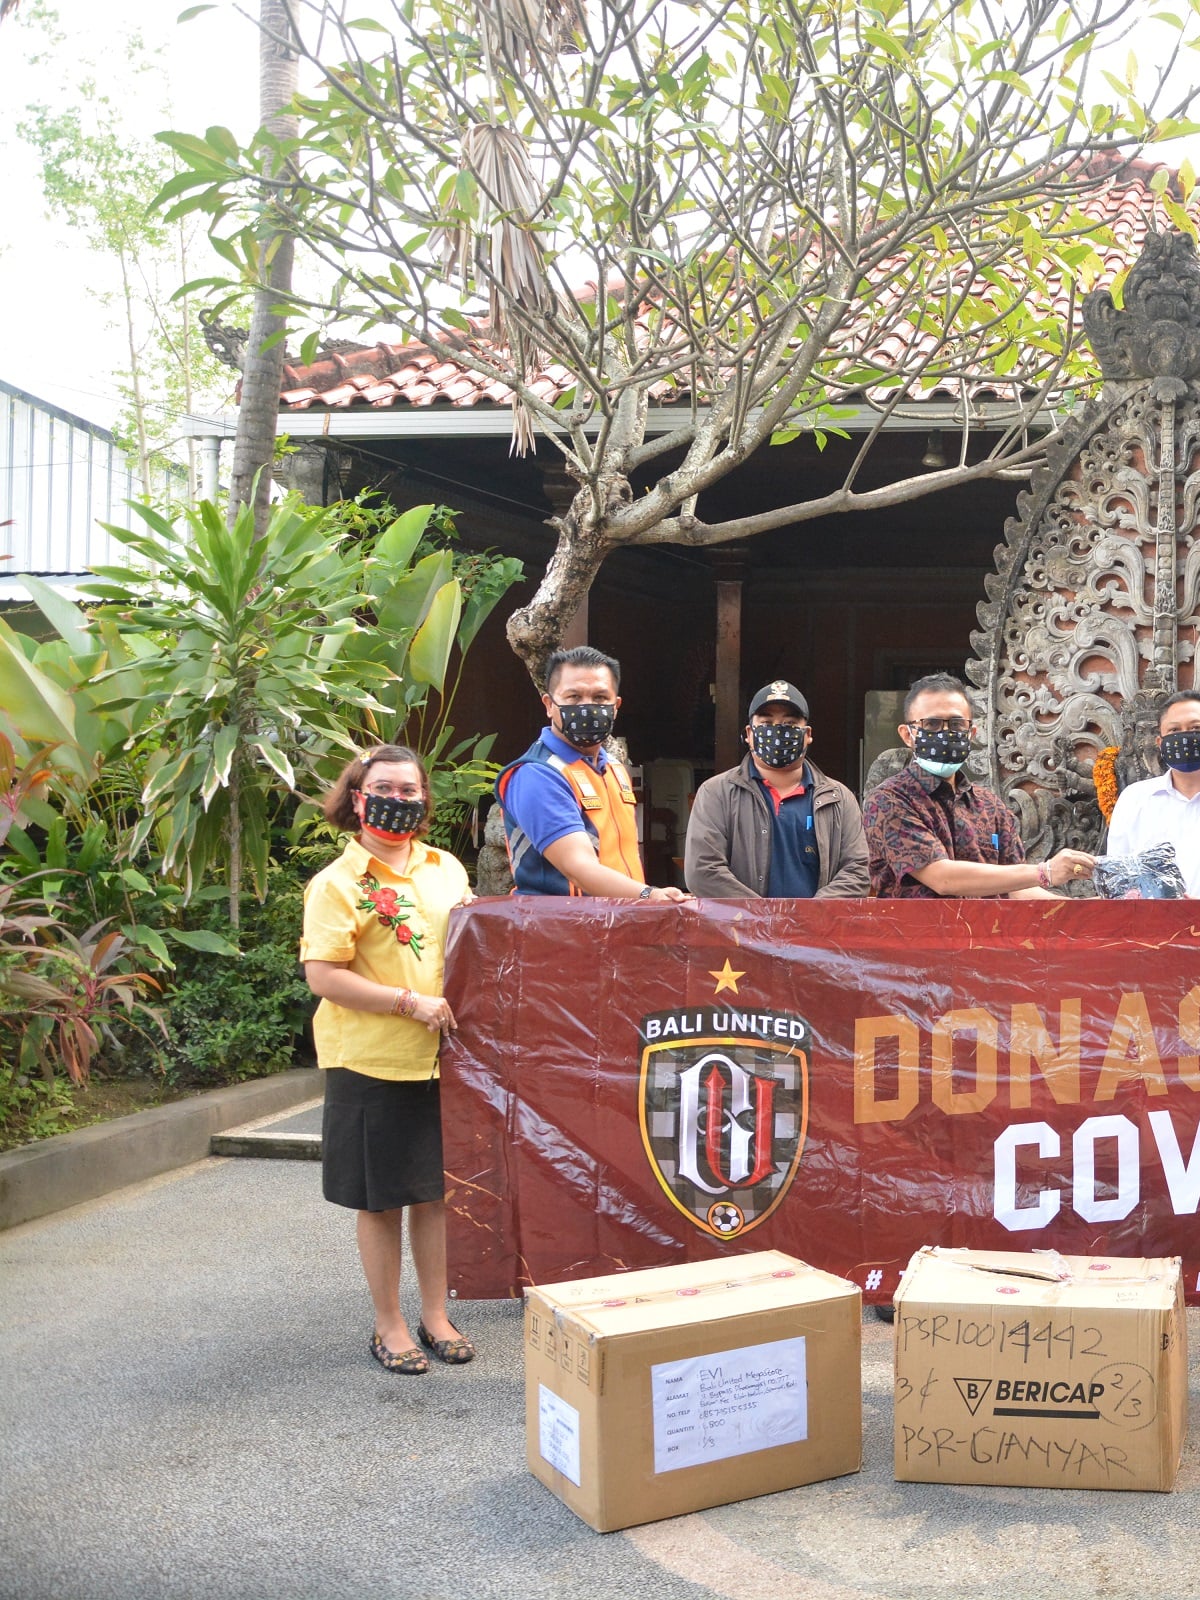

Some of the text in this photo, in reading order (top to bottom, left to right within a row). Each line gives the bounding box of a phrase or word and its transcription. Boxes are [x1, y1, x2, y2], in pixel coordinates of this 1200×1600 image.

[646, 1013, 805, 1040] BALI UNITED
[665, 1376, 683, 1385] NAMA
[700, 1367, 723, 1381] EVI
[718, 1373, 743, 1387] United
[666, 1392, 689, 1401] ALAMAT
[967, 1383, 979, 1400] B
[995, 1380, 1105, 1404] BERICAP
[666, 1425, 695, 1436] QUANTITY
[667, 1445, 679, 1453] BOX
